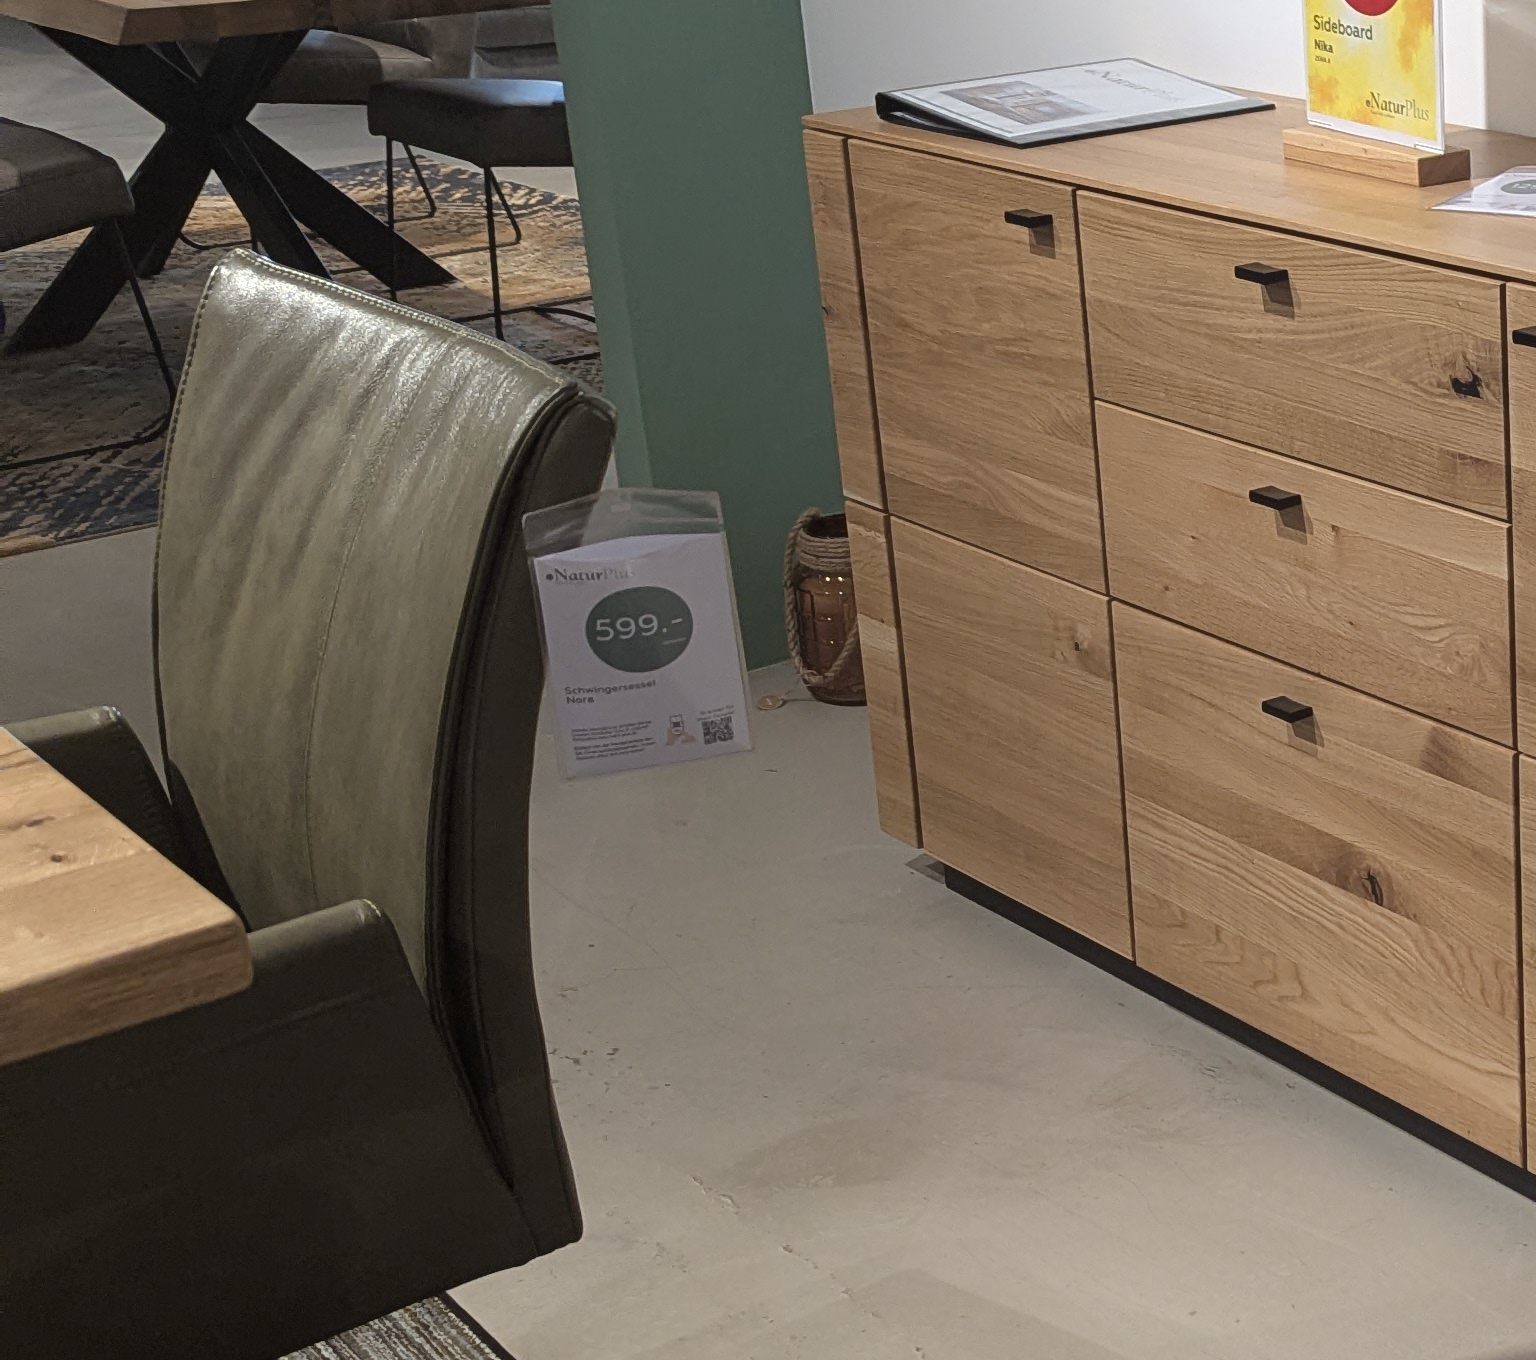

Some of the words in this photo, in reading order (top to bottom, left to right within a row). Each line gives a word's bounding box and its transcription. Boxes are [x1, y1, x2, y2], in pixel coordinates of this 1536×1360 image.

[1313, 14, 1373, 41] Sideboard
[1314, 39, 1334, 54] Nika
[595, 613, 683, 642] 599.-
[566, 696, 595, 705] Nora
